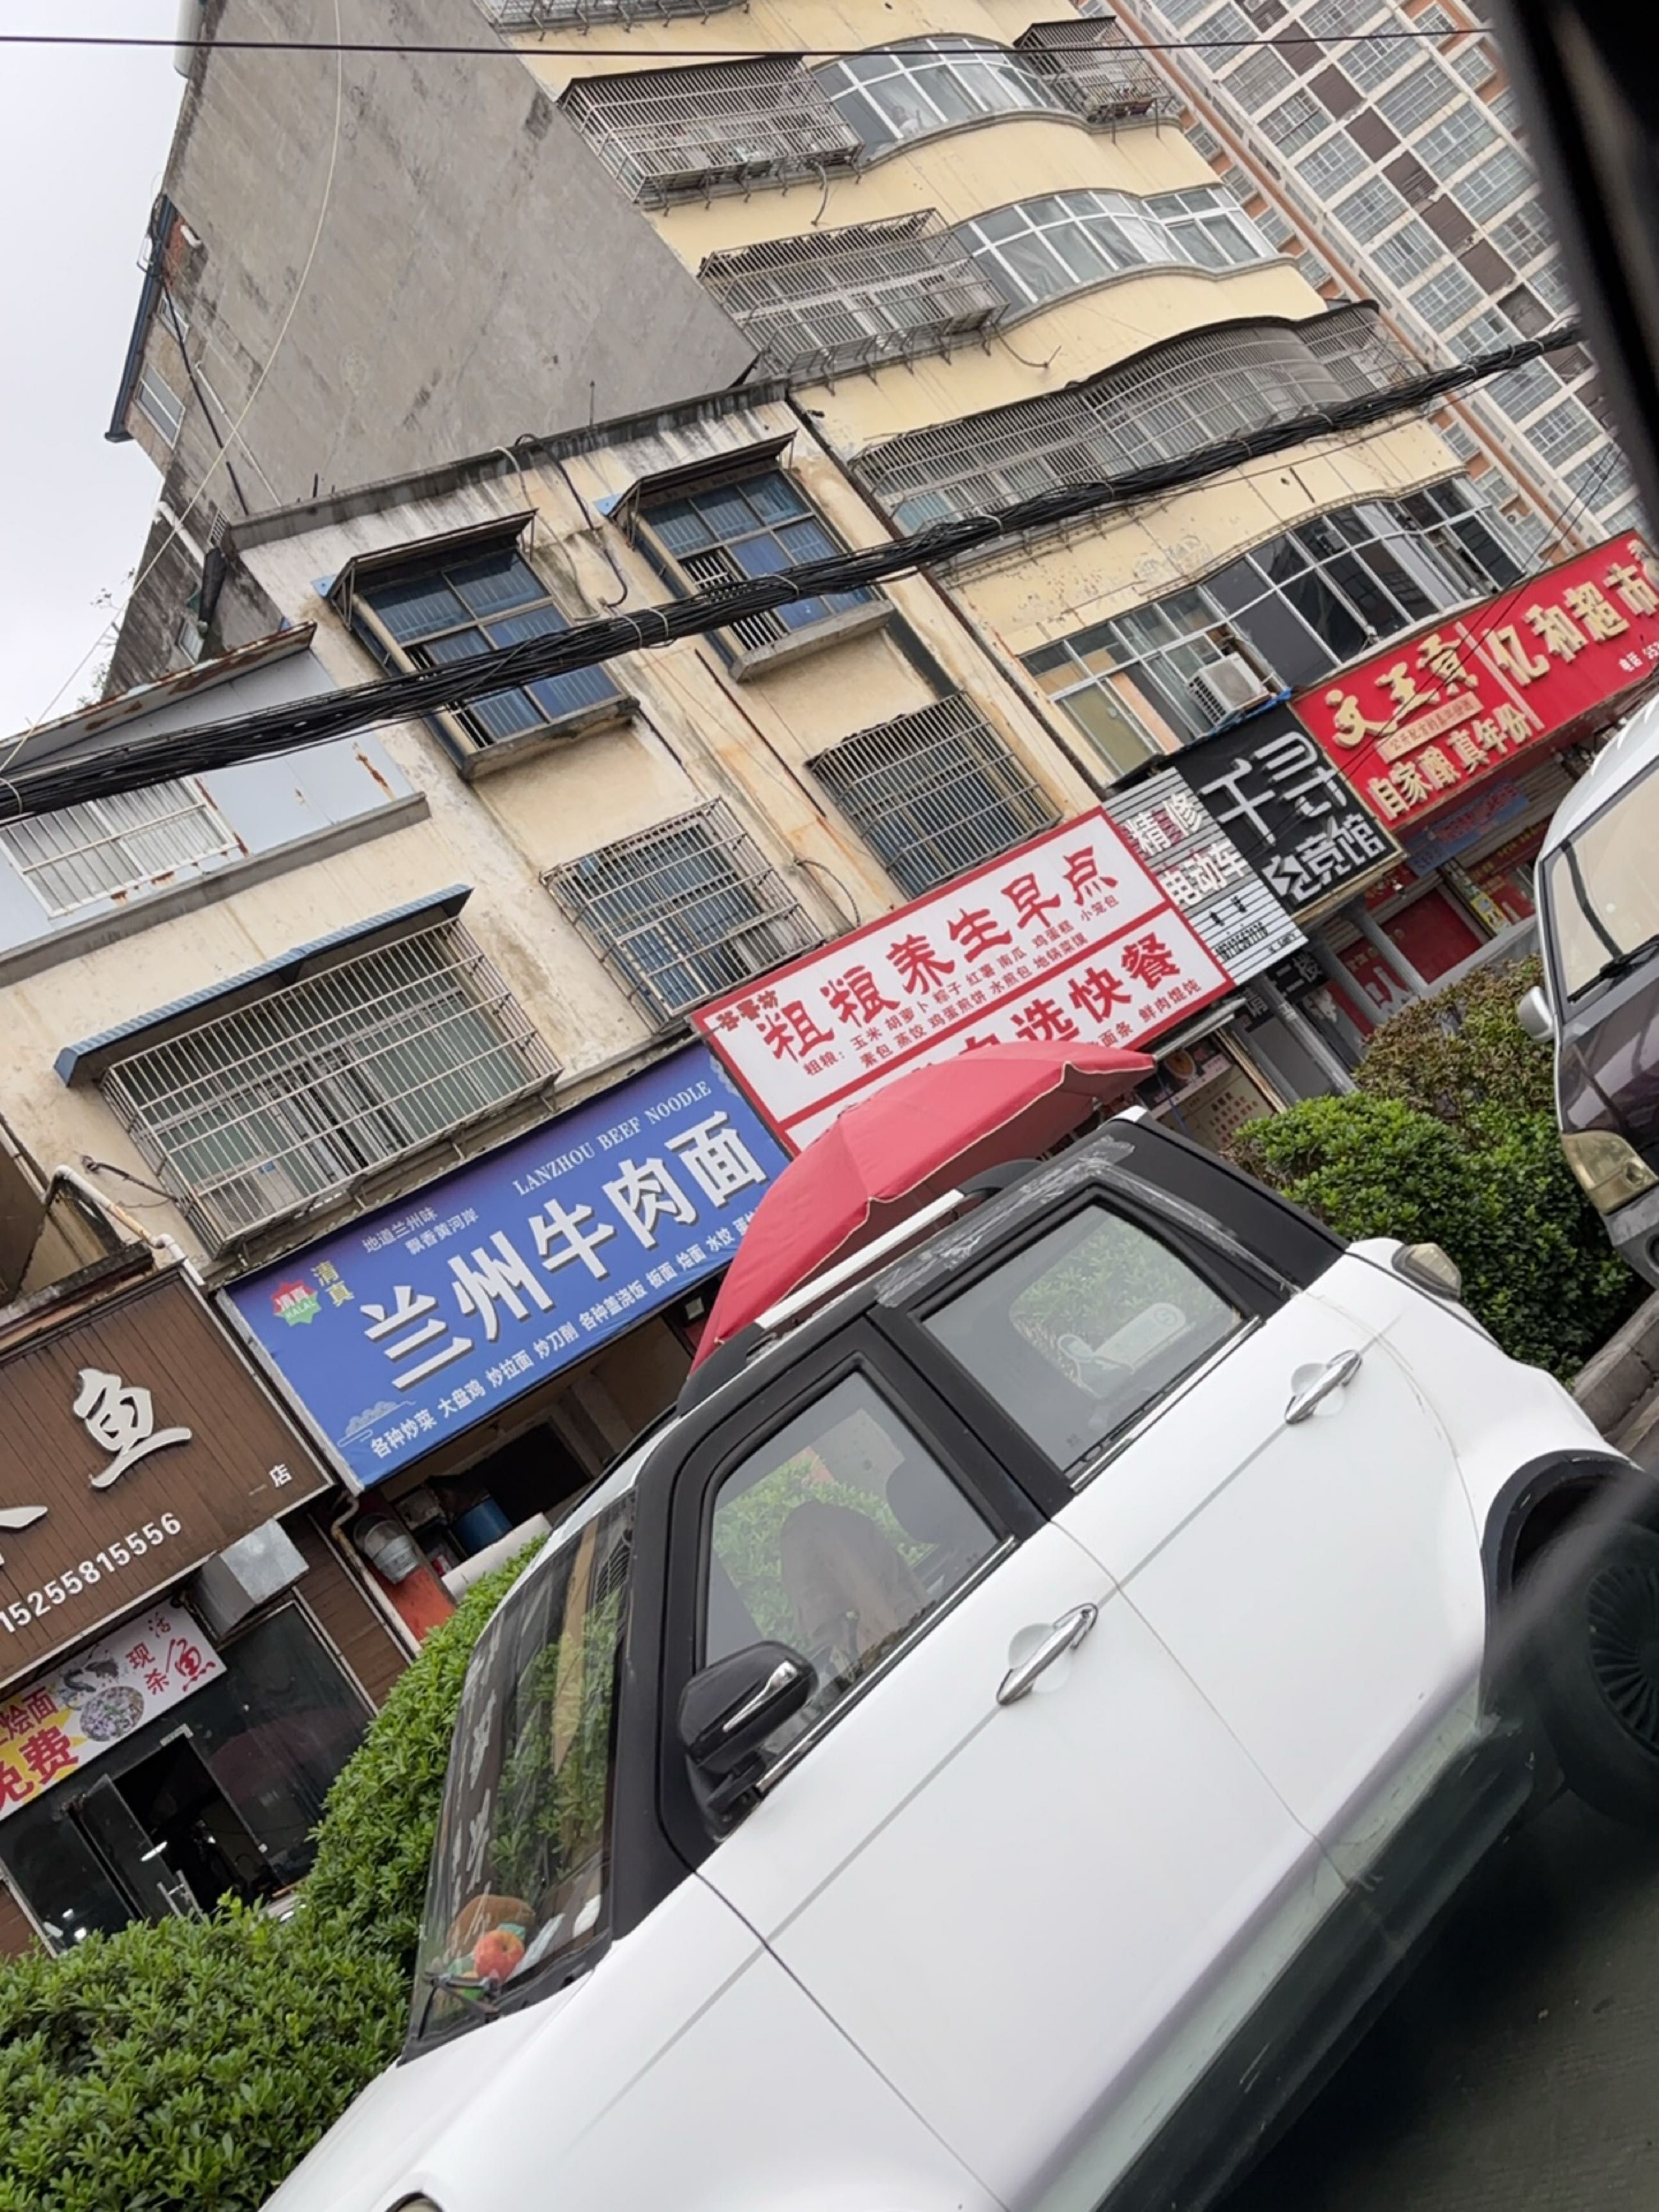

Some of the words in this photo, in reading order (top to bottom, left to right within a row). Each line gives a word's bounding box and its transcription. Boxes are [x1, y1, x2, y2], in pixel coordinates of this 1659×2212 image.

[1482, 563, 1659, 688] 亿和超市
[1325, 634, 1479, 749] 文王贡
[1126, 792, 1205, 856] 精修
[1159, 840, 1249, 907] 电动车
[1260, 812, 1388, 903] 电竞馆
[757, 846, 1119, 1063] 粗粮养生早点
[850, 1027, 882, 1050] 玉米
[885, 1000, 928, 1030] 胡萝卜
[966, 963, 995, 986] 红薯
[997, 946, 1027, 968] 南瓜
[1080, 895, 1119, 921] 小笼包
[1243, 954, 1322, 1018] 请二楼
[861, 1044, 893, 1068] 素包
[990, 966, 1032, 994] 水煎包
[1089, 1022, 1134, 1048] 面条
[513, 1142, 595, 1196] LANZHOU
[597, 1116, 641, 1151] BEEF
[644, 1081, 712, 1125] NOODLE
[360, 1110, 768, 1391] 兰州牛肉面
[361, 1207, 438, 1253] 地道兰州味
[405, 1207, 479, 1254] 飘香黄河岸
[310, 1260, 354, 1307] 清真
[371, 1409, 437, 1459] 各种炒菜
[438, 1379, 486, 1418] 大盘鸡
[485, 1350, 534, 1388] 炒拉面
[533, 1321, 579, 1359] 炒刀削
[645, 1262, 677, 1289] 板面
[676, 1244, 707, 1270] 烩面
[706, 1228, 734, 1252] 水饺
[73, 1368, 193, 1490] 鱼
[0, 1512, 181, 1633] 15255815556
[0, 1686, 59, 1747] 烩面
